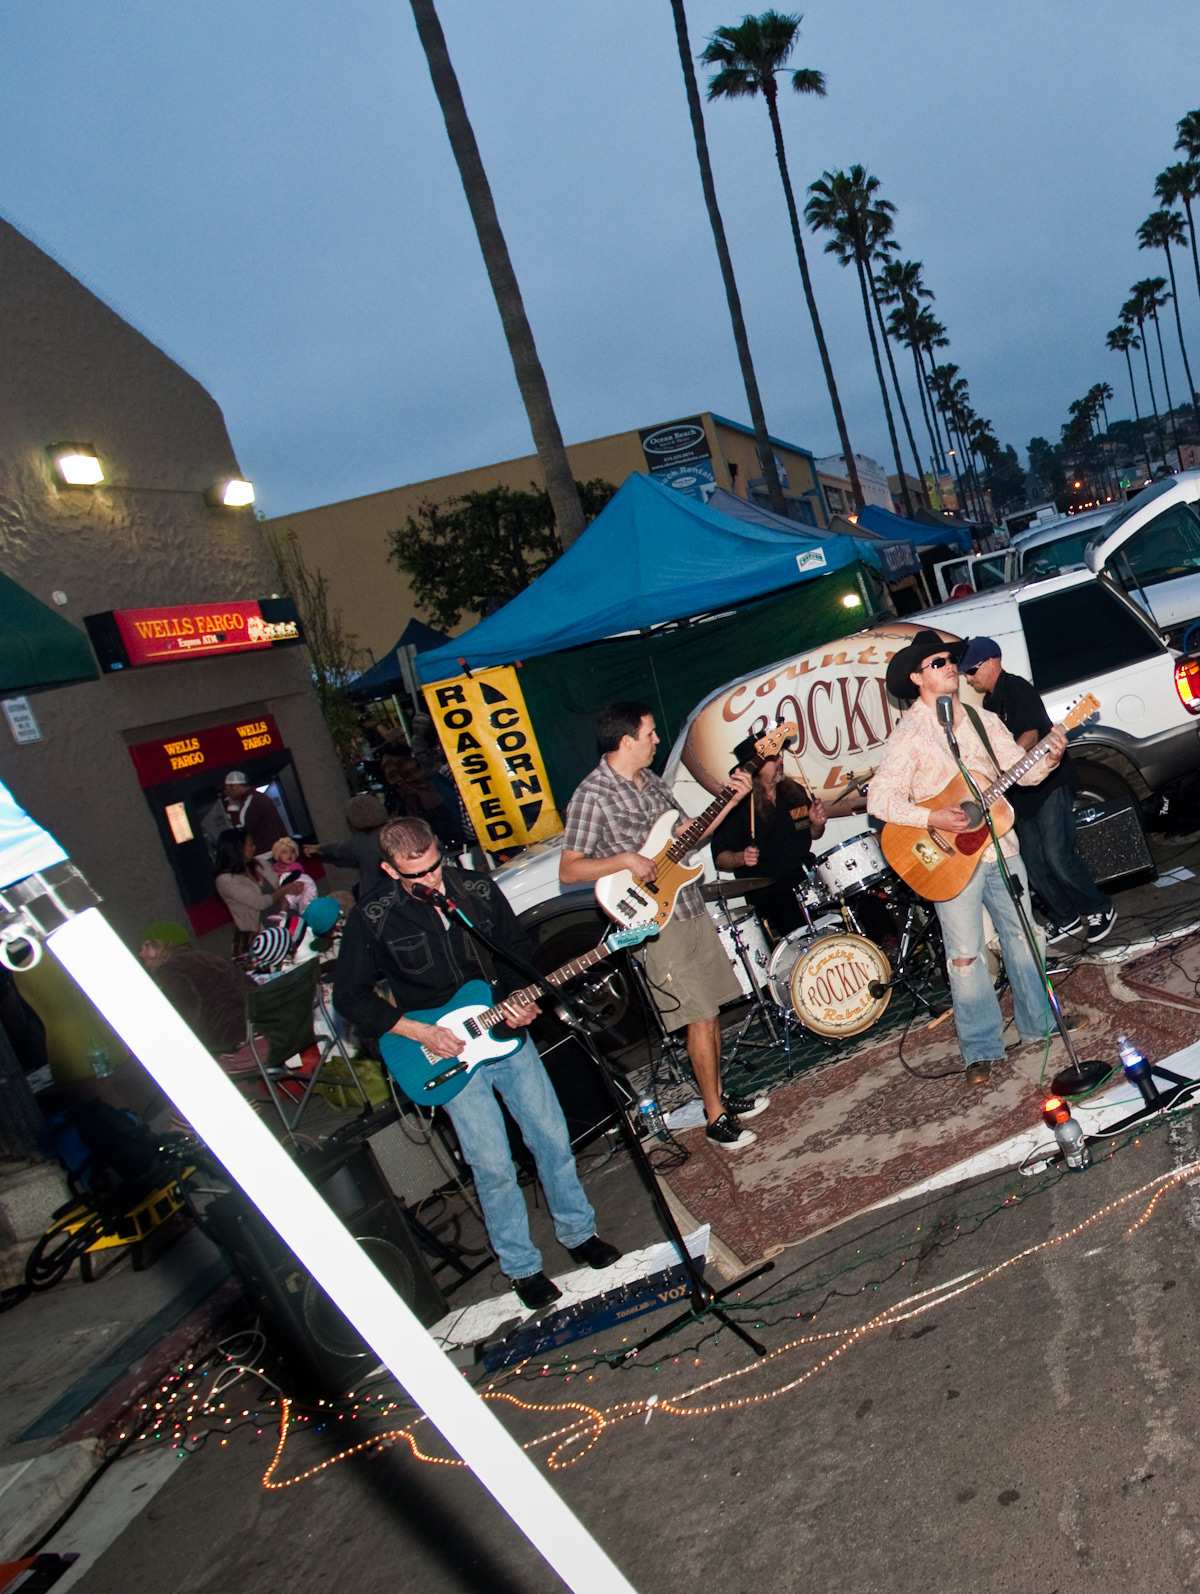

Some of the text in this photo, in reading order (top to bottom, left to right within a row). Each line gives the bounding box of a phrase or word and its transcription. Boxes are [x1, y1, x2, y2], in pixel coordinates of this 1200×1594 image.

[134, 613, 244, 639] WELLS FARGO
[237, 722, 268, 738] WELLS
[164, 738, 200, 756] WELLS
[242, 735, 272, 750] FARGO
[170, 752, 204, 770] FARGO
[435, 684, 513, 842] ROASTED
[490, 708, 542, 799] CORN
[657, 1283, 688, 1303] VOX
